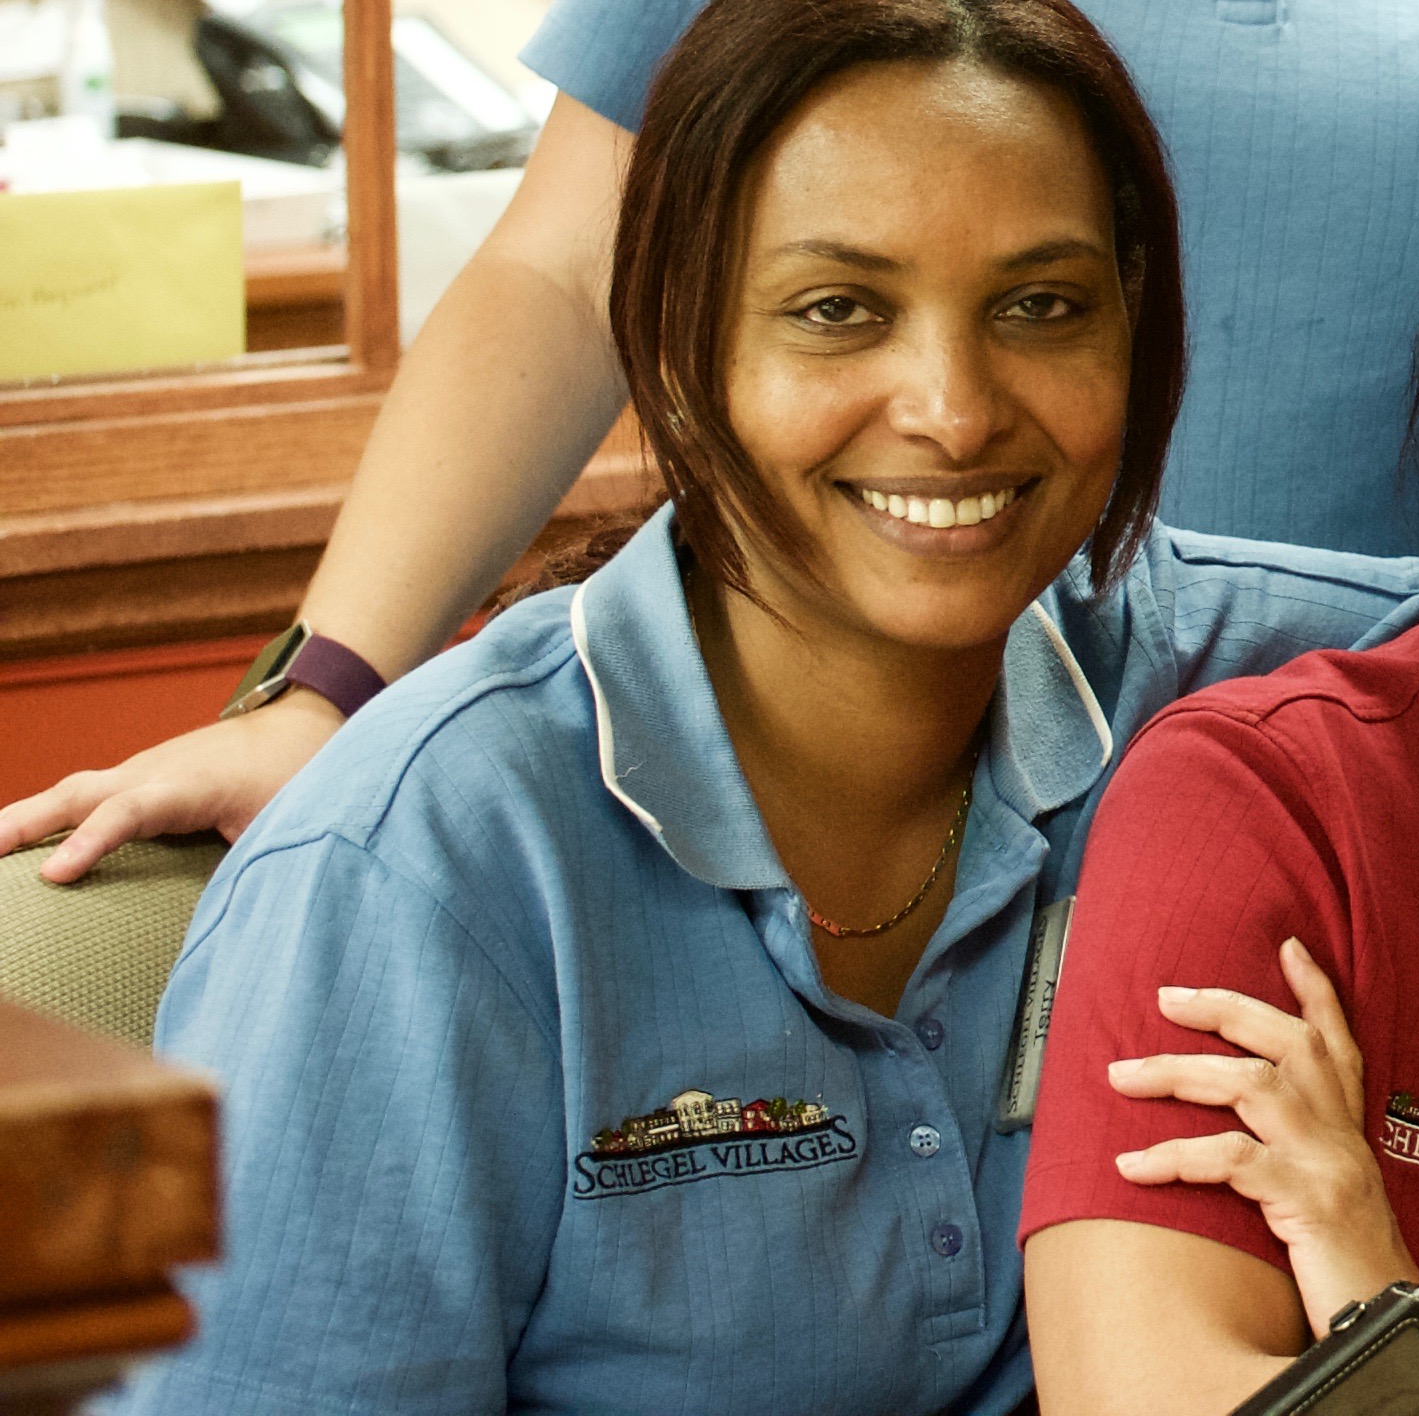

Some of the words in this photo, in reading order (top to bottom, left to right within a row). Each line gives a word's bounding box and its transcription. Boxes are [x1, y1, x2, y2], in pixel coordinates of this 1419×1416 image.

[1033, 979, 1056, 1047] Terry
[574, 1151, 706, 1194] SCHLEGEL
[711, 1114, 857, 1169] VILLAGES
